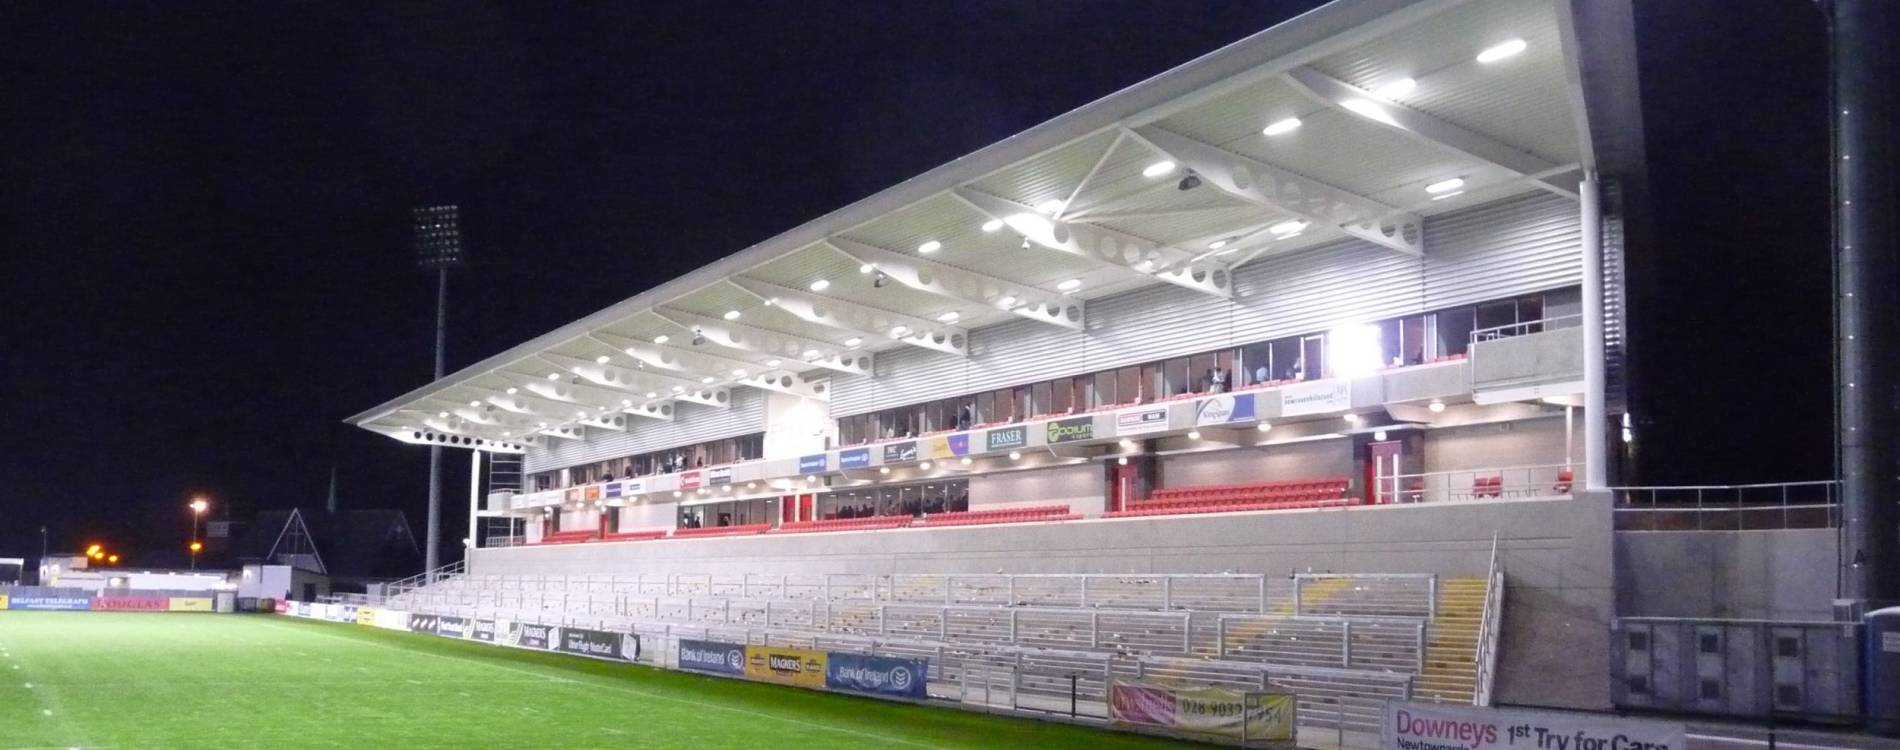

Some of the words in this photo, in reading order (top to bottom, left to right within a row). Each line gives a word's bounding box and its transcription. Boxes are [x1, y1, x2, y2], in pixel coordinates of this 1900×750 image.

[991, 430, 1021, 444] FRASER
[681, 648, 696, 661] Bank
[696, 649, 703, 662] of
[703, 650, 725, 665] Ireland
[770, 655, 801, 671] MAGNERS
[839, 666, 855, 679] Bank
[855, 668, 865, 681] of
[865, 668, 889, 683] Ireland
[1183, 698, 1205, 715] 028
[1397, 709, 1497, 748] Downeys
[1507, 724, 1531, 746] 1st
[1534, 727, 1570, 750] Try
[1574, 730, 1608, 750] for
